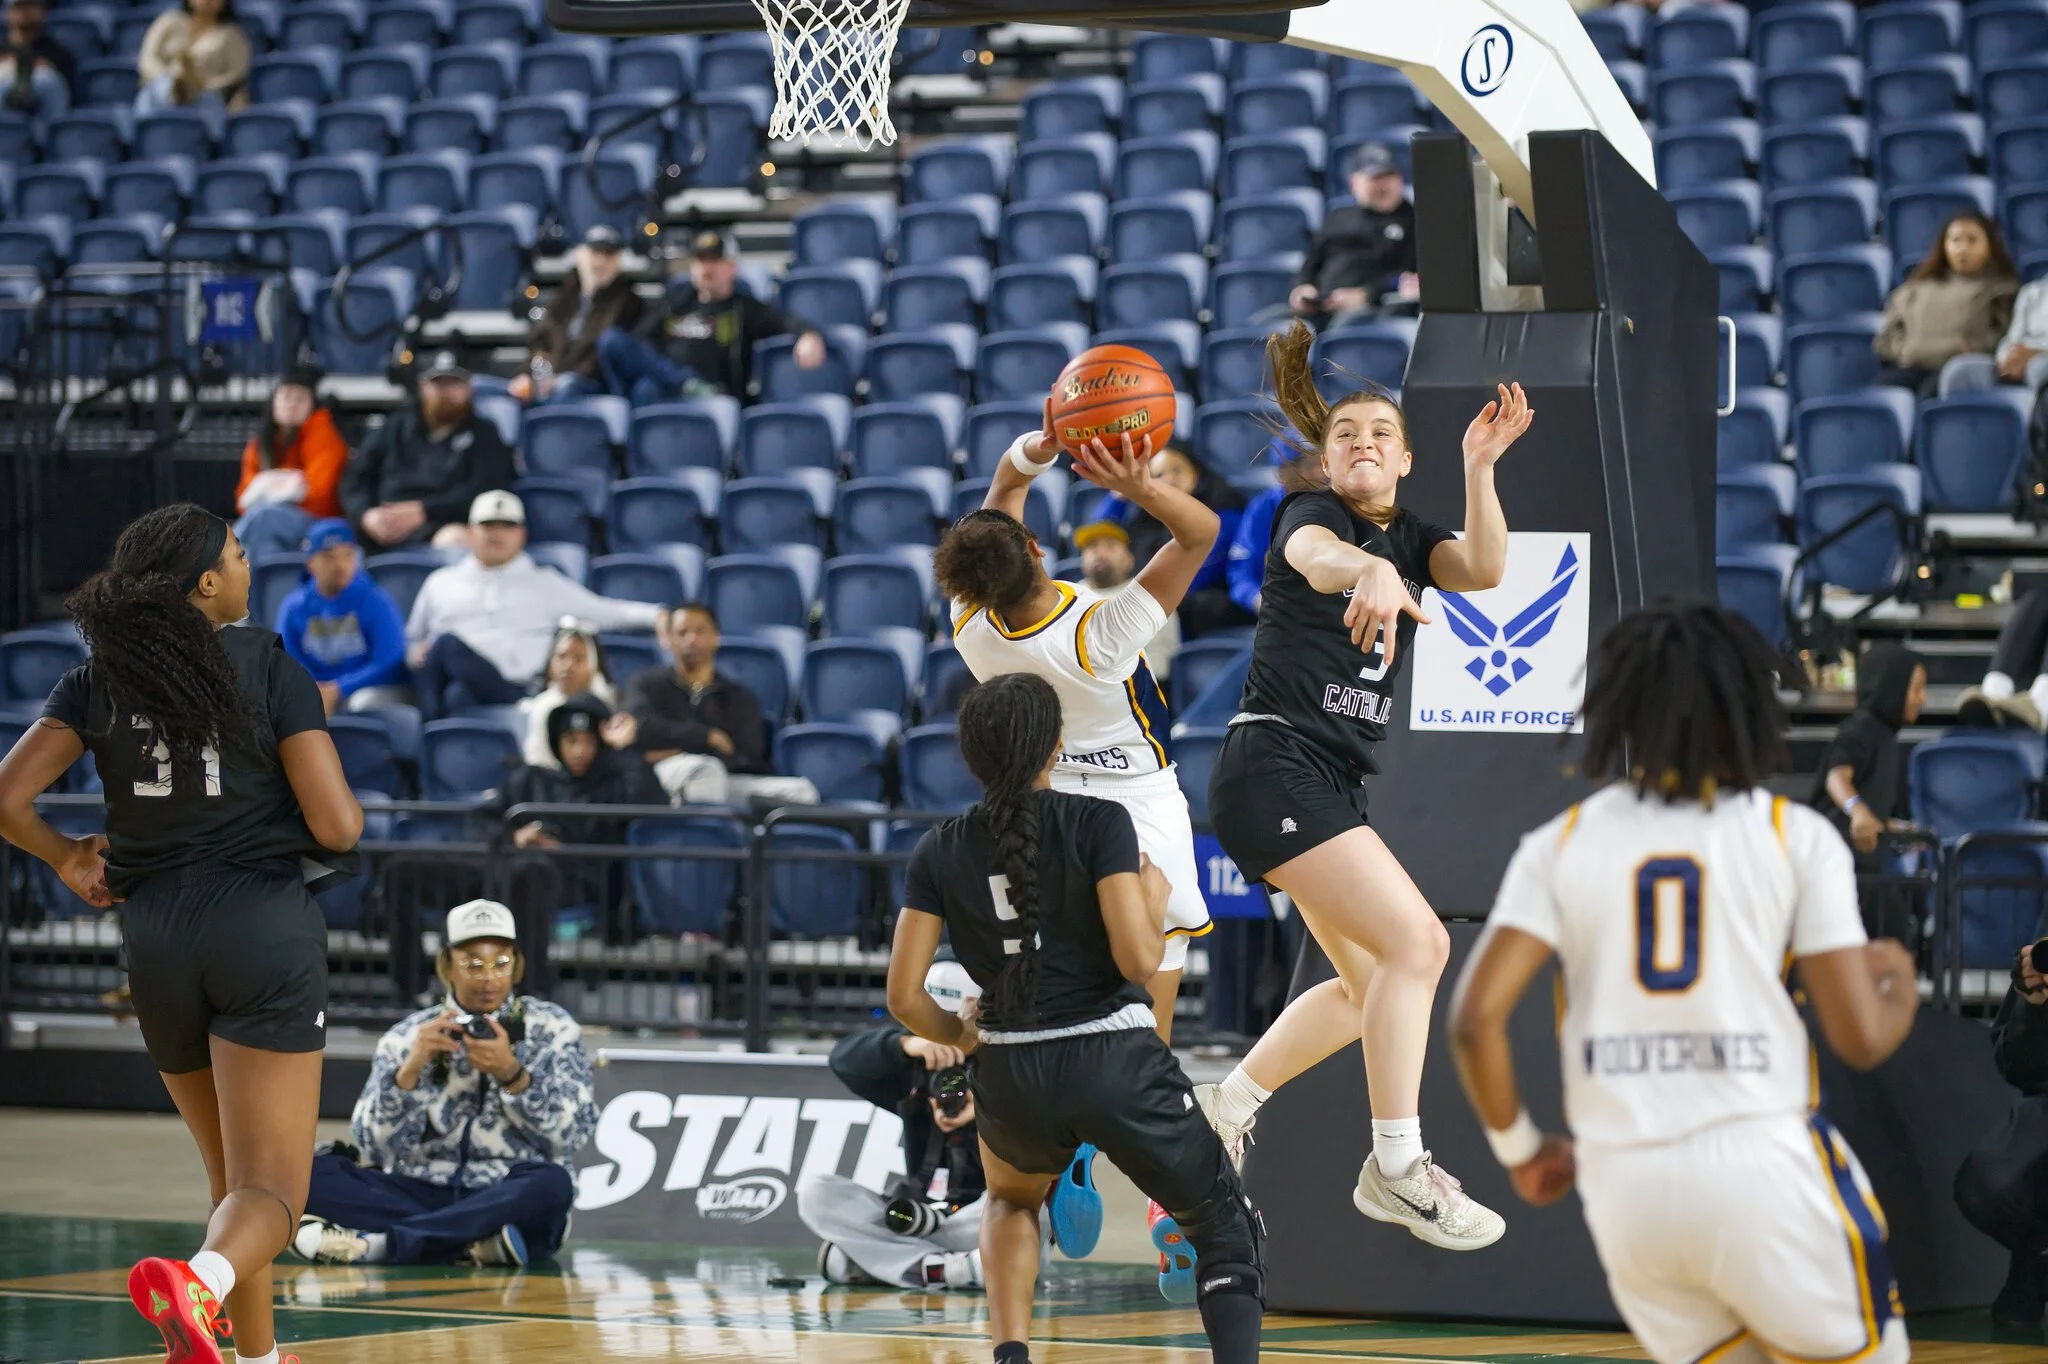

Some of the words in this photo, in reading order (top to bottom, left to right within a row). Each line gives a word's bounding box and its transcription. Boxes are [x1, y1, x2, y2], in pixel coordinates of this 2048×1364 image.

[1119, 406, 1150, 431] PRO
[1323, 683, 1393, 725] CATHLI
[1420, 709, 1457, 723] U.S.
[1461, 710, 1496, 724] AIR
[1501, 711, 1575, 726] FORCE
[131, 714, 222, 797] 31
[988, 874, 1042, 955] 5
[1633, 853, 1706, 998] 0
